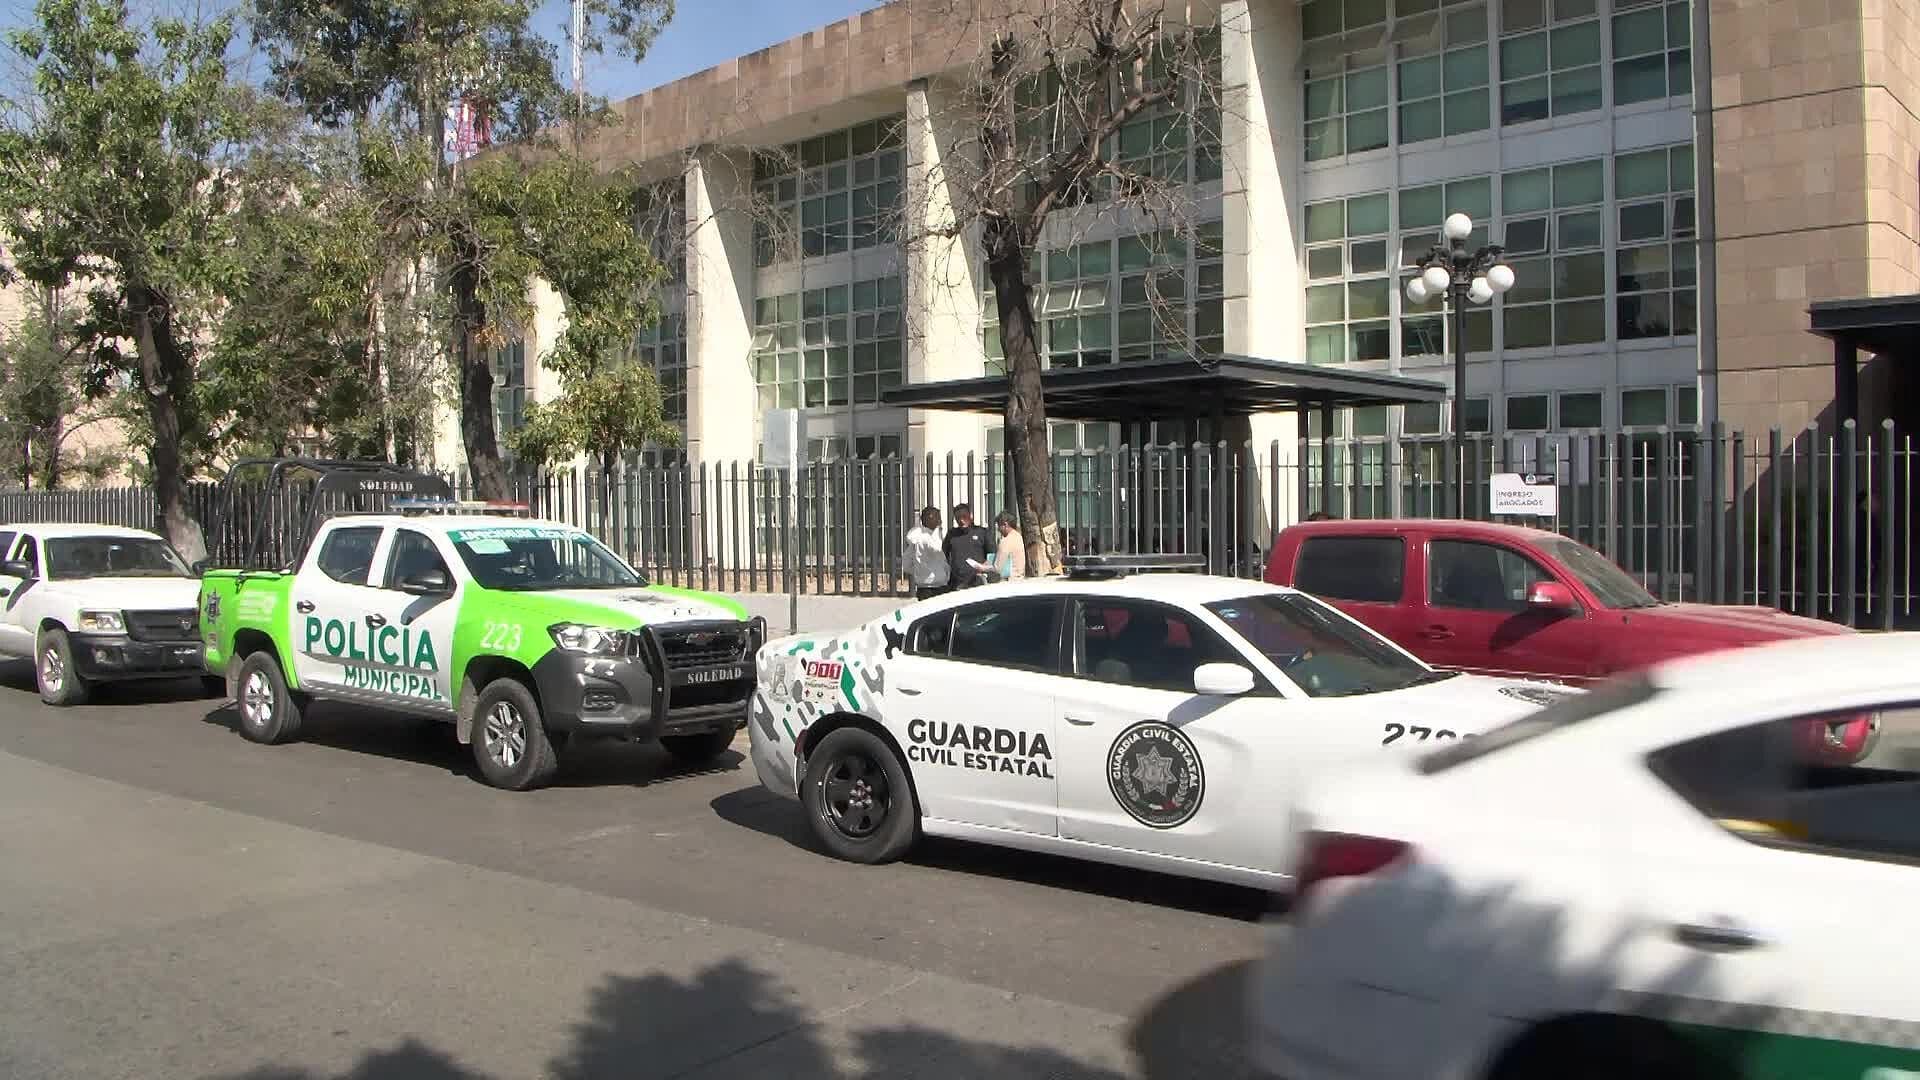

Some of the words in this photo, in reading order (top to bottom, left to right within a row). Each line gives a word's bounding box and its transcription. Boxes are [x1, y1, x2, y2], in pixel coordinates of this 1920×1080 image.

[360, 481, 413, 492] SOLEDAD
[480, 619, 522, 652] 223
[344, 665, 441, 699] MUNICIPAL
[687, 667, 742, 684] SOLEDAD
[806, 661, 841, 679] 911
[907, 718, 1052, 760] GUARDIA
[1112, 733, 1141, 780] GUARDIA
[1142, 729, 1171, 742] CIVIL
[907, 745, 958, 766] CIVIL
[963, 751, 1054, 779] ESTATAL
